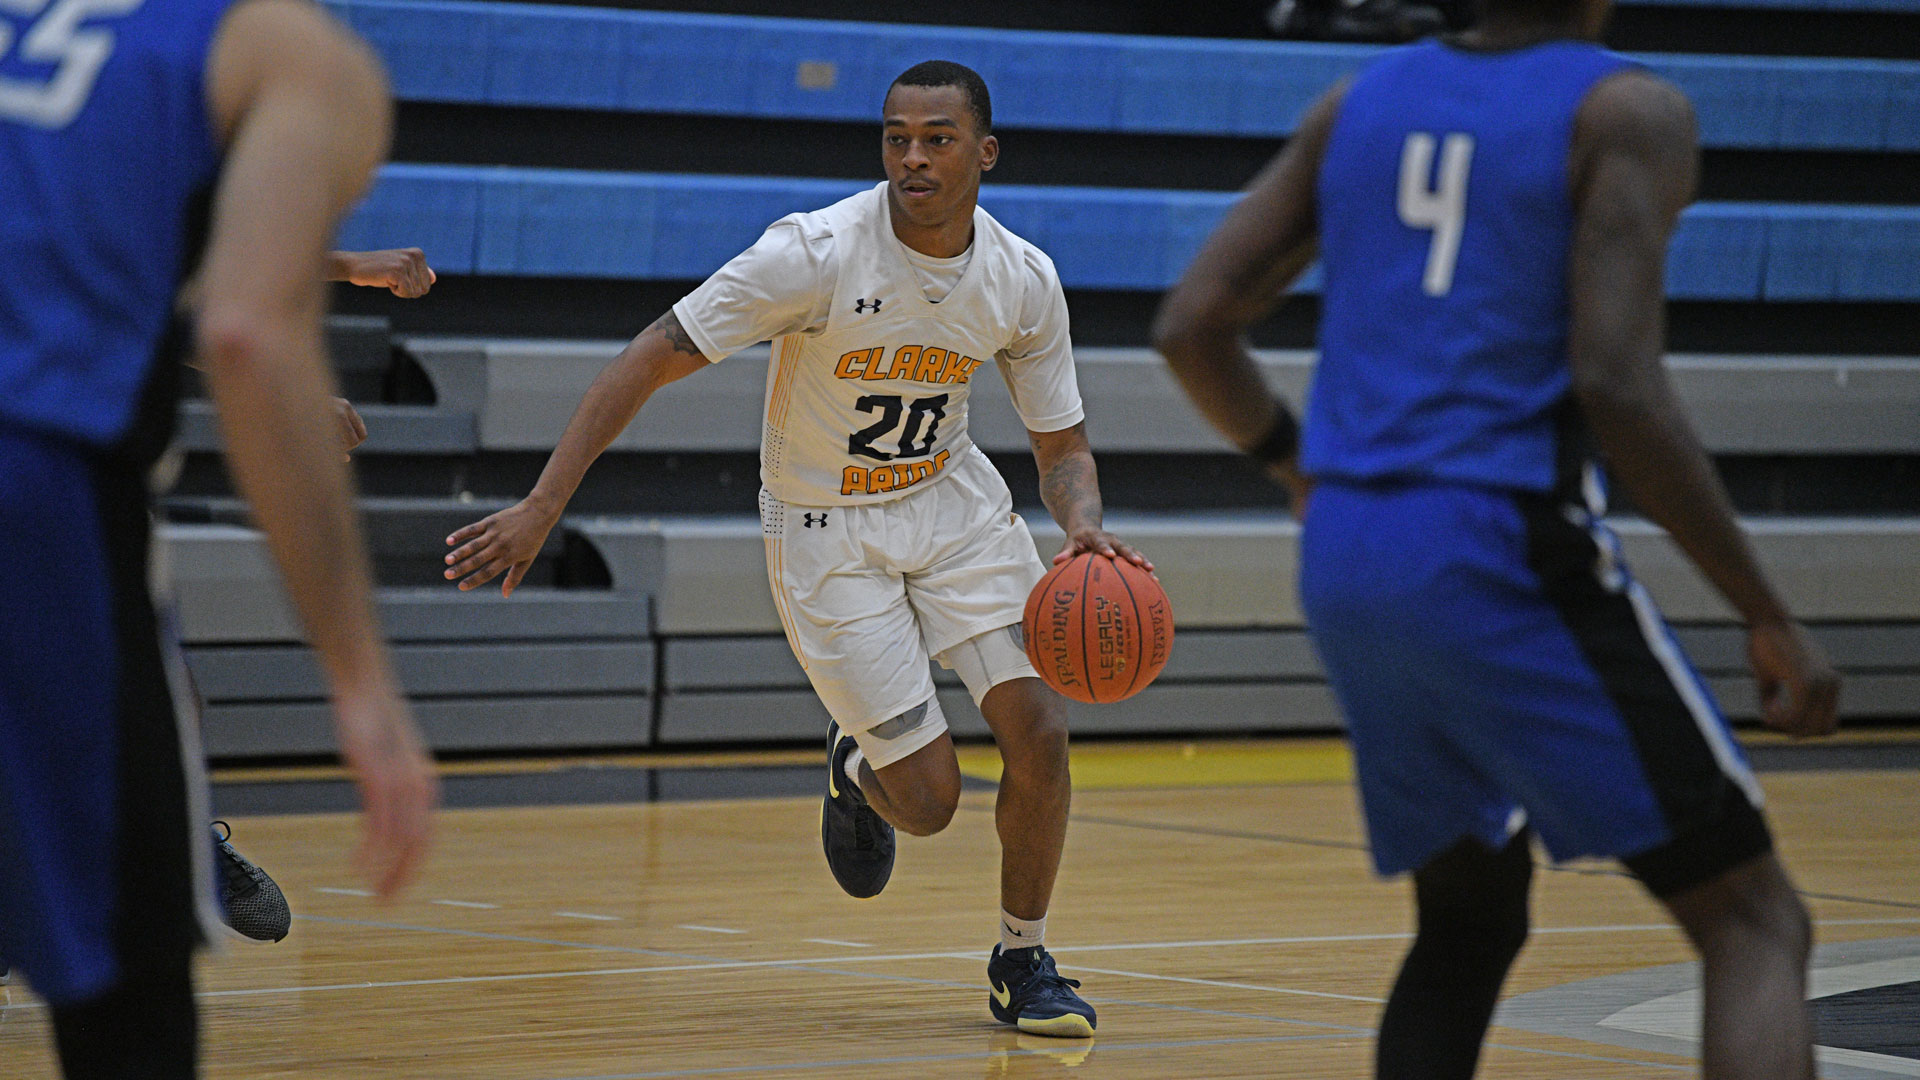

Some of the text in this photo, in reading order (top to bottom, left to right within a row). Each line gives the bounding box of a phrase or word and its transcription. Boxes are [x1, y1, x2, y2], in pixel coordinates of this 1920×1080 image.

[0, 0, 147, 129] 5
[1397, 131, 1476, 297] 4
[848, 393, 949, 461] 20
[1053, 590, 1081, 687] SPALDING
[1095, 596, 1114, 681] LEGACY
